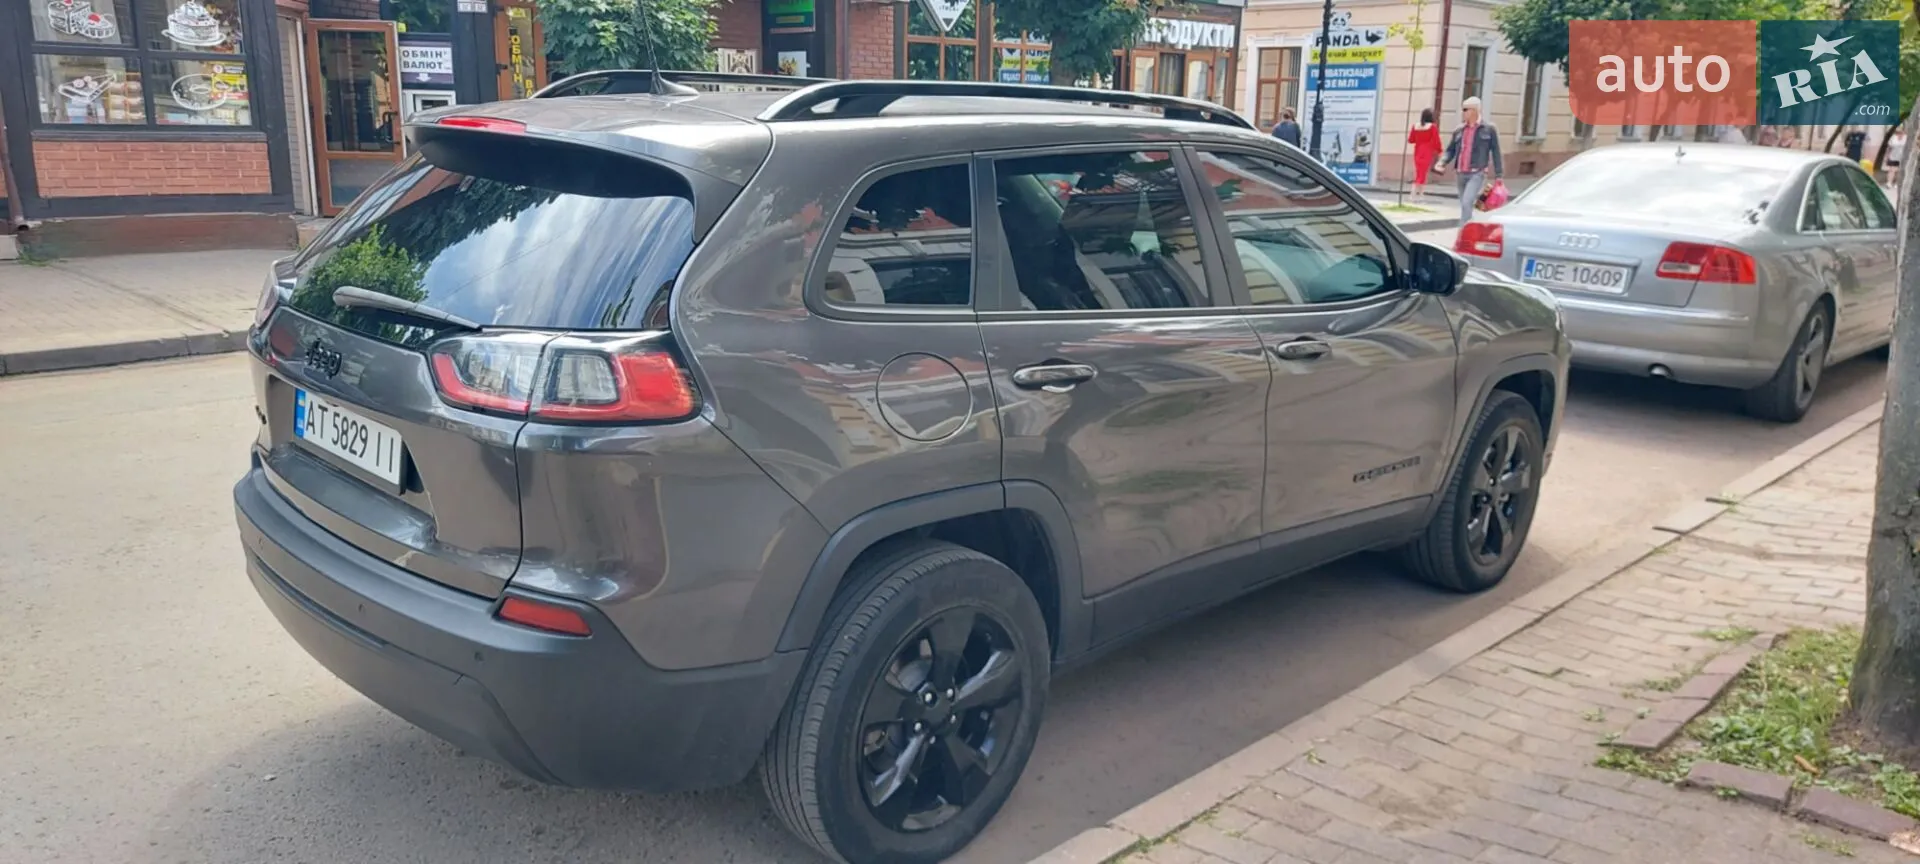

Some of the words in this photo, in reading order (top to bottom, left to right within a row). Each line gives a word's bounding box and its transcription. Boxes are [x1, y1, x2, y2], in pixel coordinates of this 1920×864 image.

[402, 50, 442, 58] ОБМІН
[403, 61, 443, 69] ВАЛЮТ
[1535, 262, 1566, 281] RDE
[1572, 267, 1623, 288] 10609
[306, 400, 329, 440] AT
[331, 411, 369, 458] 5829
